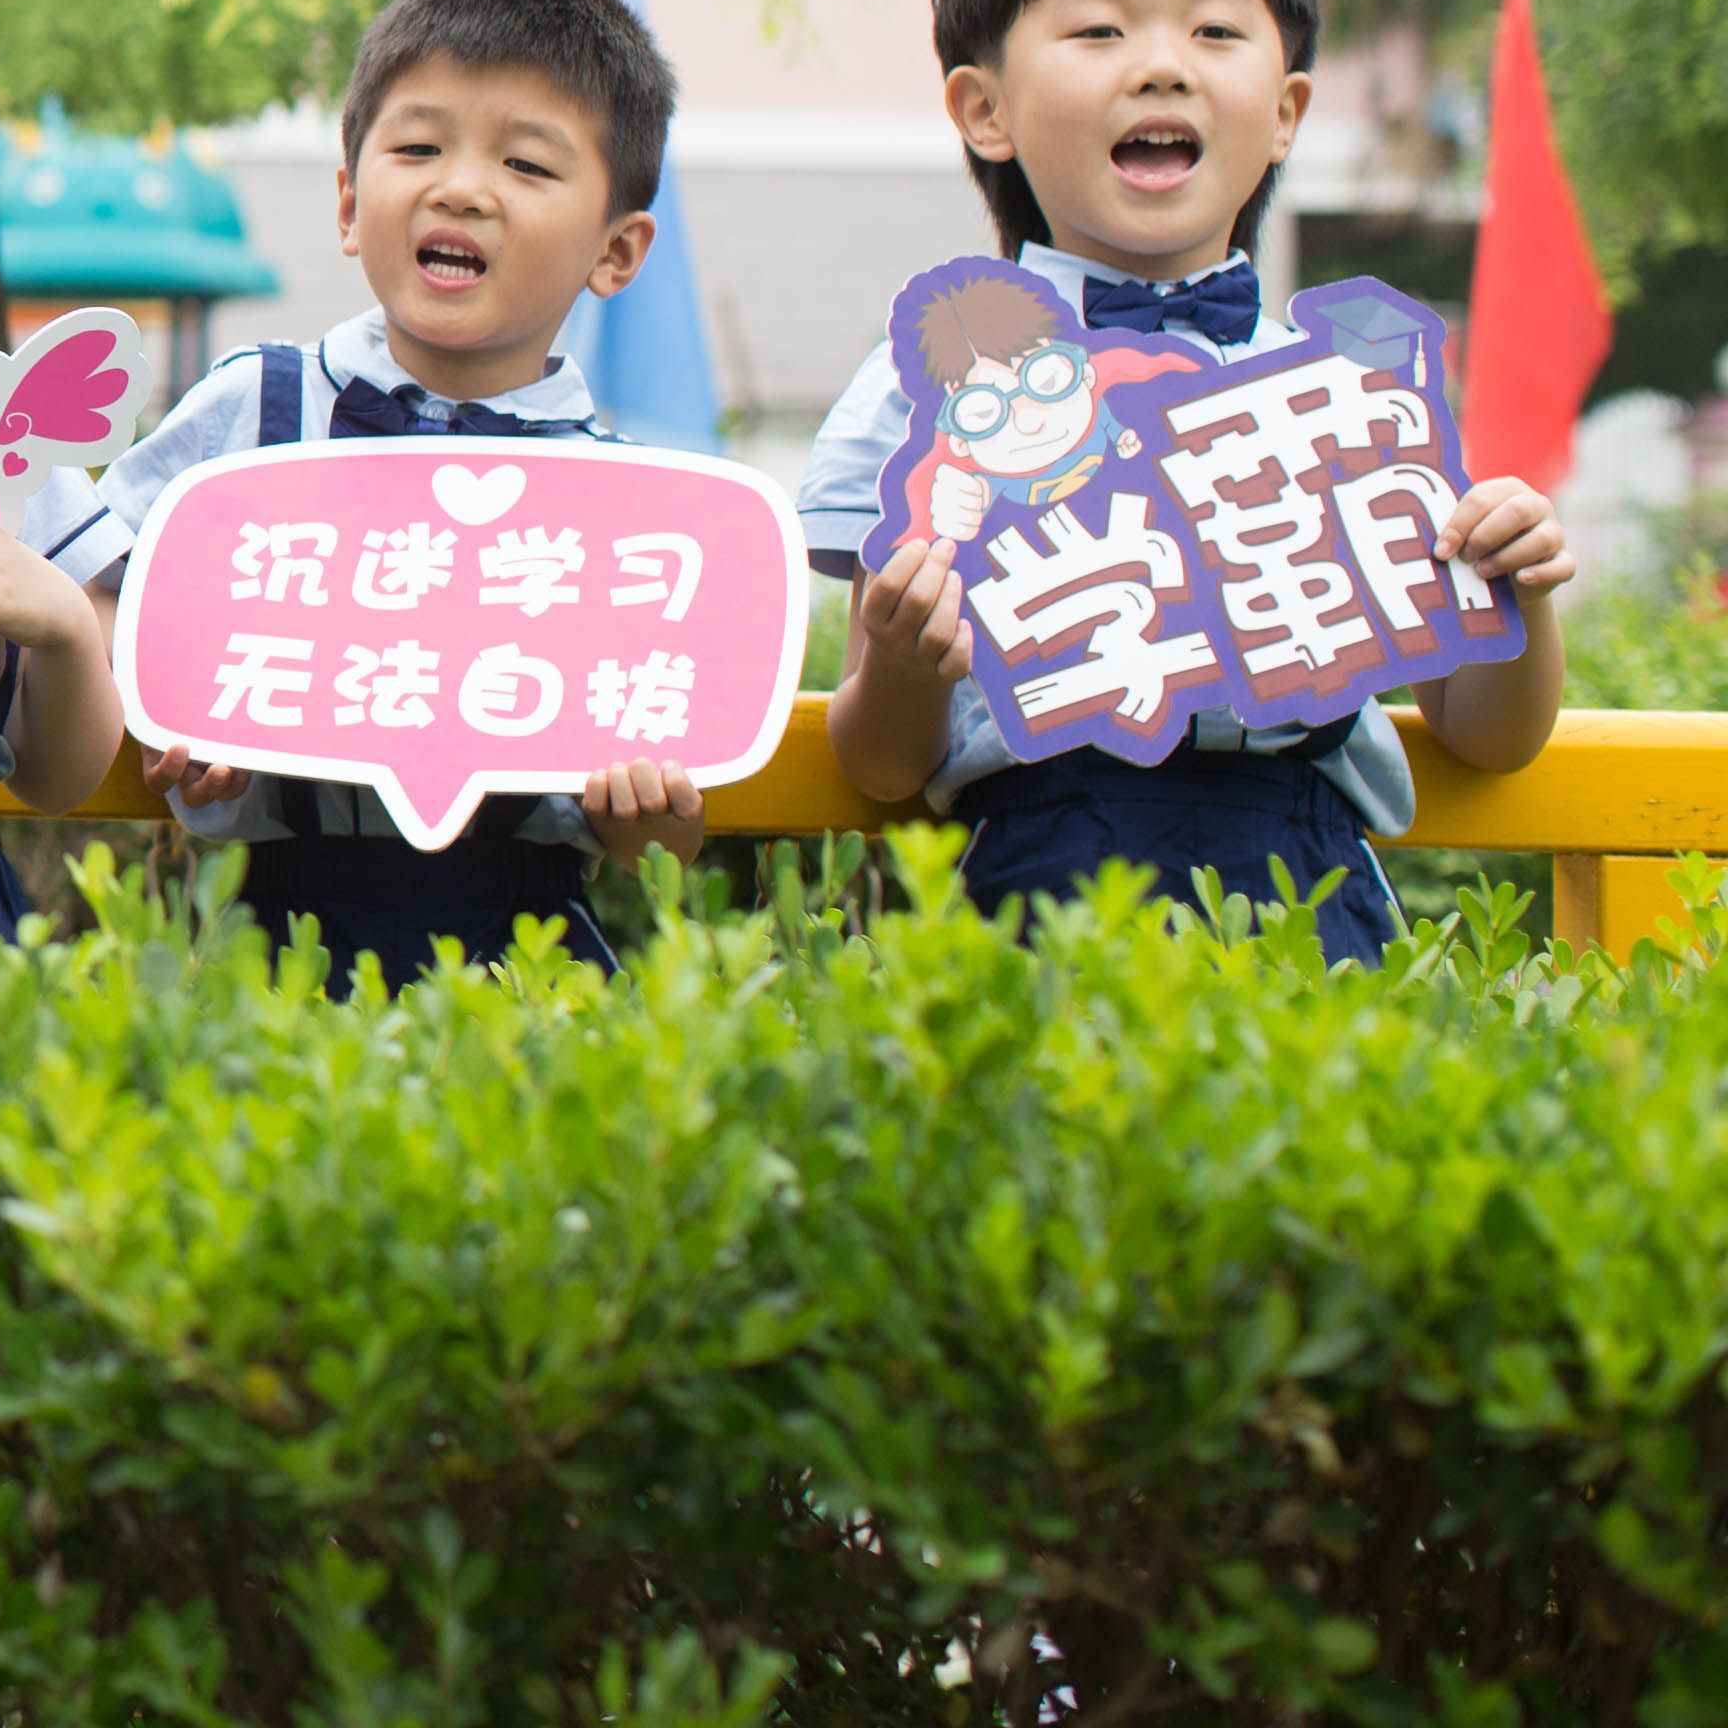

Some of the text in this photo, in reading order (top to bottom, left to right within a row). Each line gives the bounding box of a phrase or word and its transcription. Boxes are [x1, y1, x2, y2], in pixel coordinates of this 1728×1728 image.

[229, 521, 704, 623] 沉迷学习
[966, 353, 1498, 727] 学霸
[208, 632, 697, 744] 无法自拔
